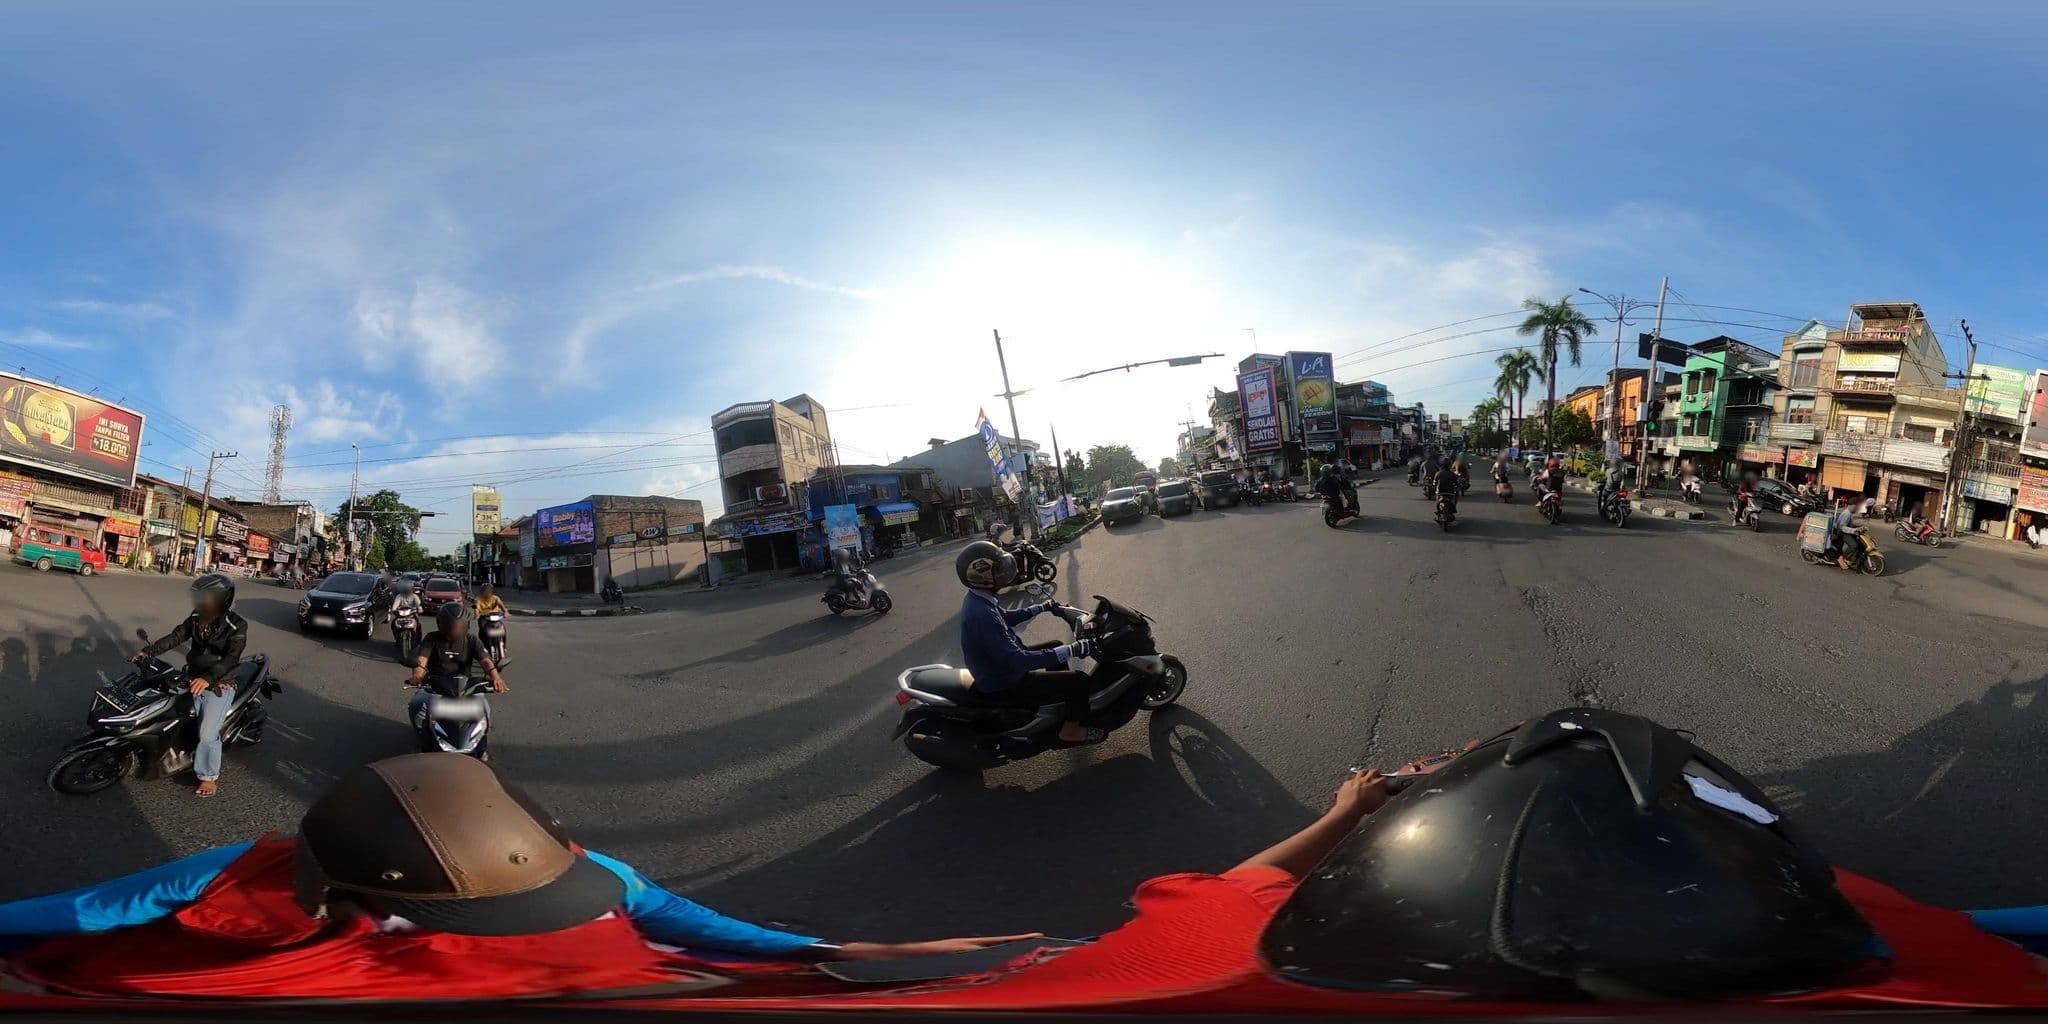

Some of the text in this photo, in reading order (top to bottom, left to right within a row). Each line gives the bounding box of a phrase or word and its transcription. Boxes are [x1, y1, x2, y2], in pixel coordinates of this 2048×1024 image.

[109, 420, 128, 433] SURYA
[1247, 417, 1276, 428] SEKOLAH
[95, 425, 129, 441] TANPA FILTER
